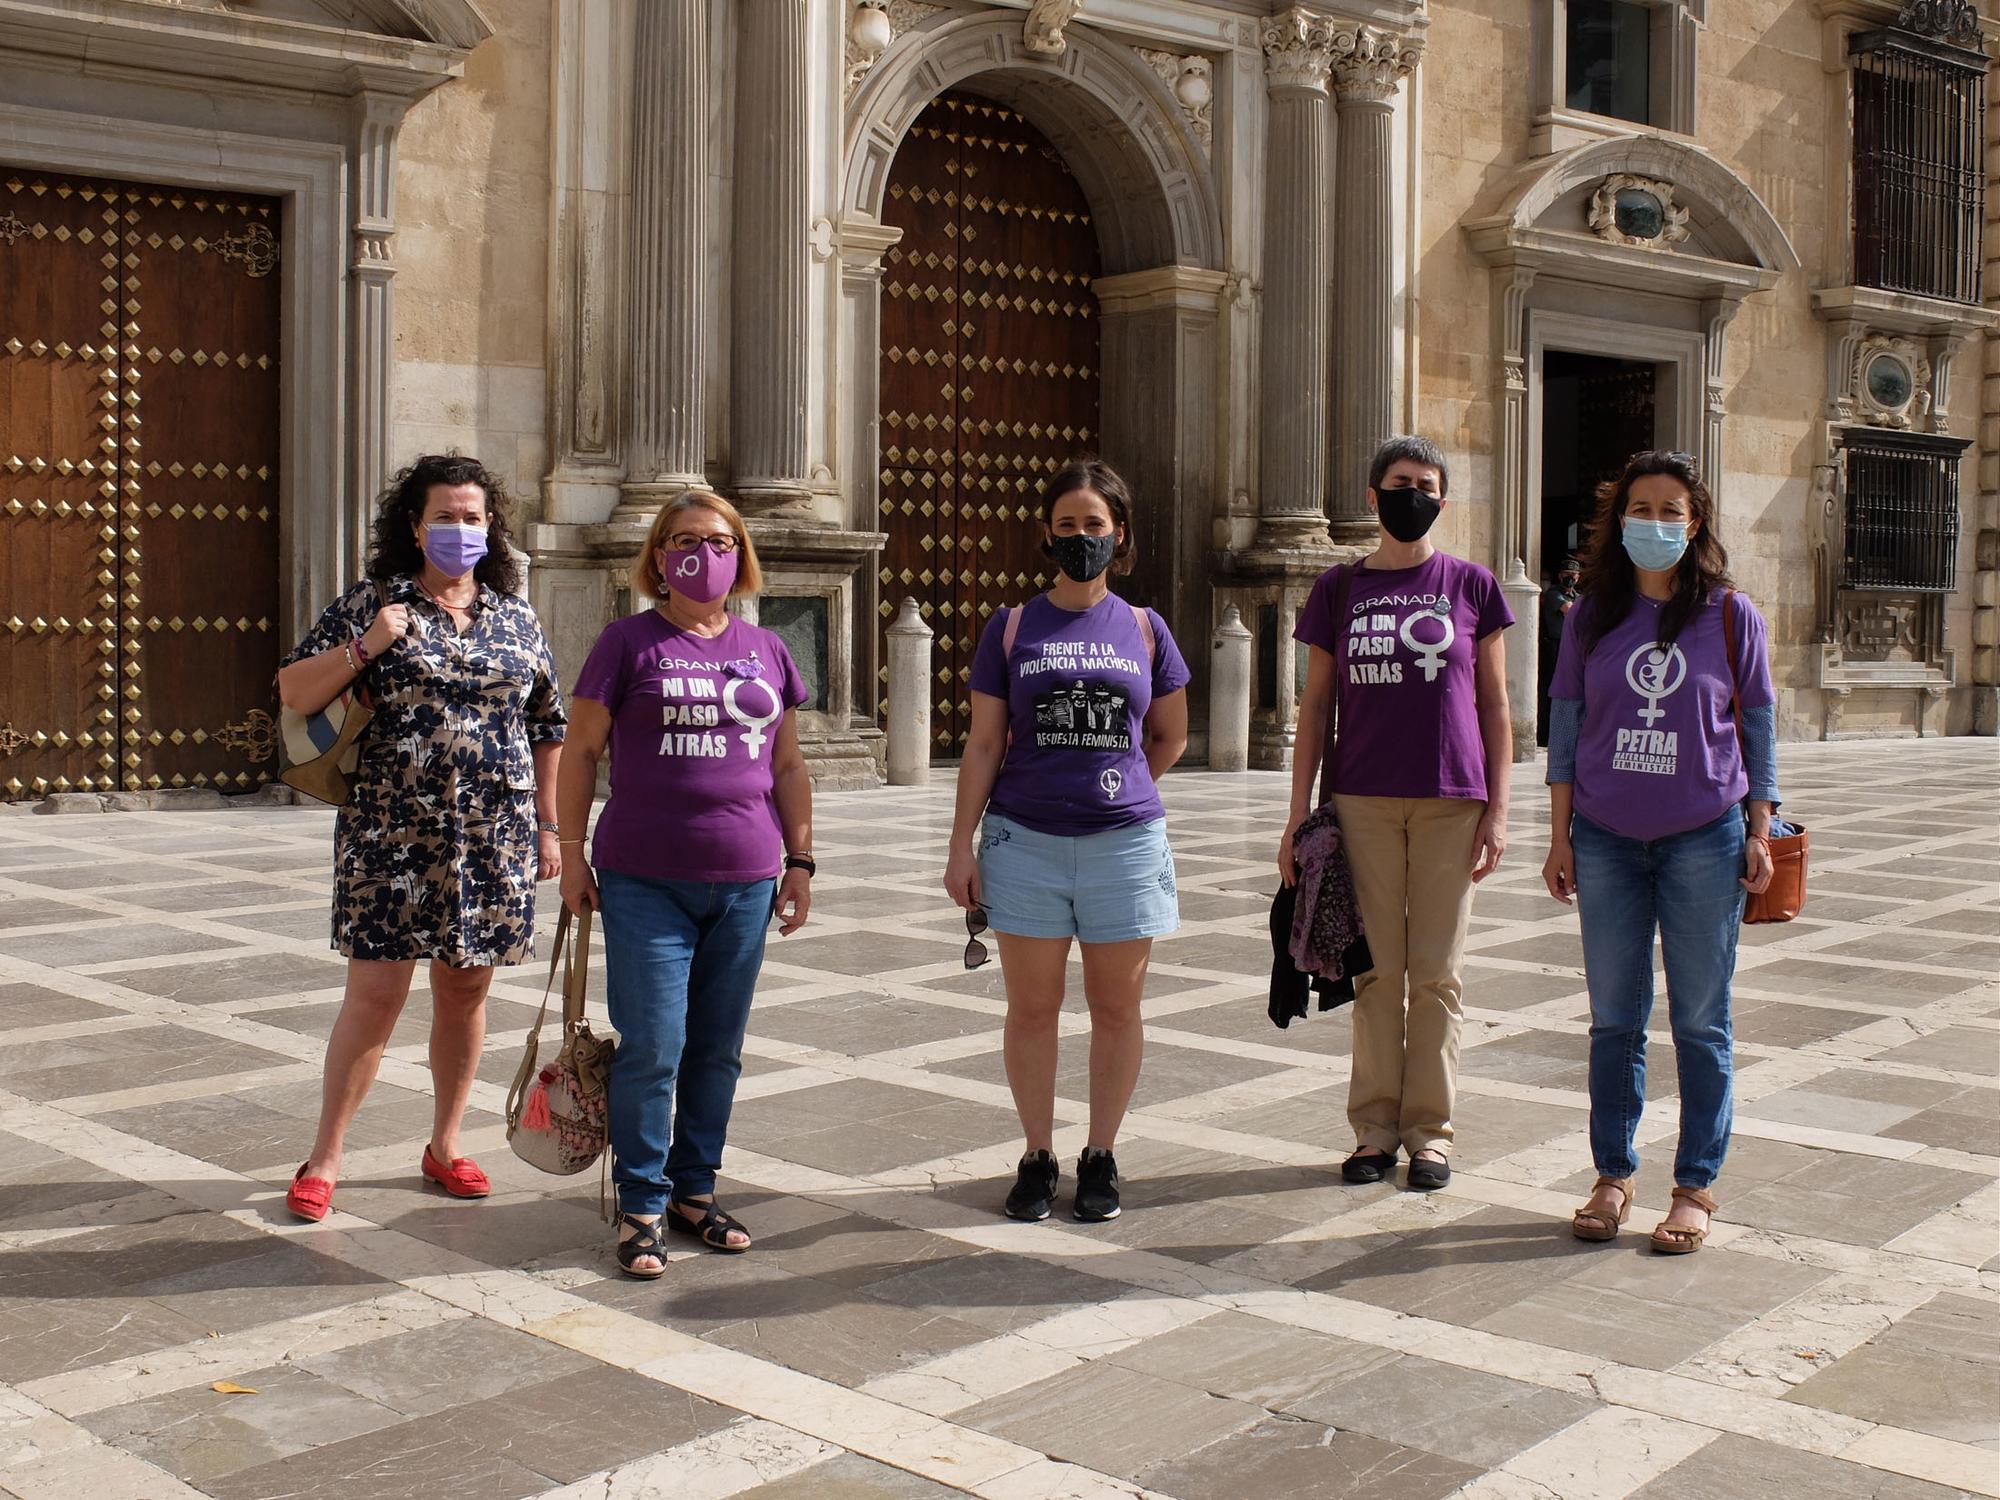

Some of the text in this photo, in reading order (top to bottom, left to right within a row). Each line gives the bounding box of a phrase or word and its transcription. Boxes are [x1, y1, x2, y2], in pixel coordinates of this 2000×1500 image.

[1350, 614, 1396, 634] NI UN
[1042, 642, 1116, 656] FRENTE A LA
[1347, 636, 1395, 658] PASO
[1020, 656, 1141, 678] VIOLENCIA MACHISTA
[1349, 659, 1403, 684] ATRÁS
[662, 677, 717, 698] NI UN
[663, 704, 719, 726] PASO
[658, 731, 727, 758] ATRÁS
[1081, 732, 1129, 749] FEMINISTA
[1615, 728, 1678, 756] PETRA
[1613, 760, 1675, 774] FEMINISTAS
